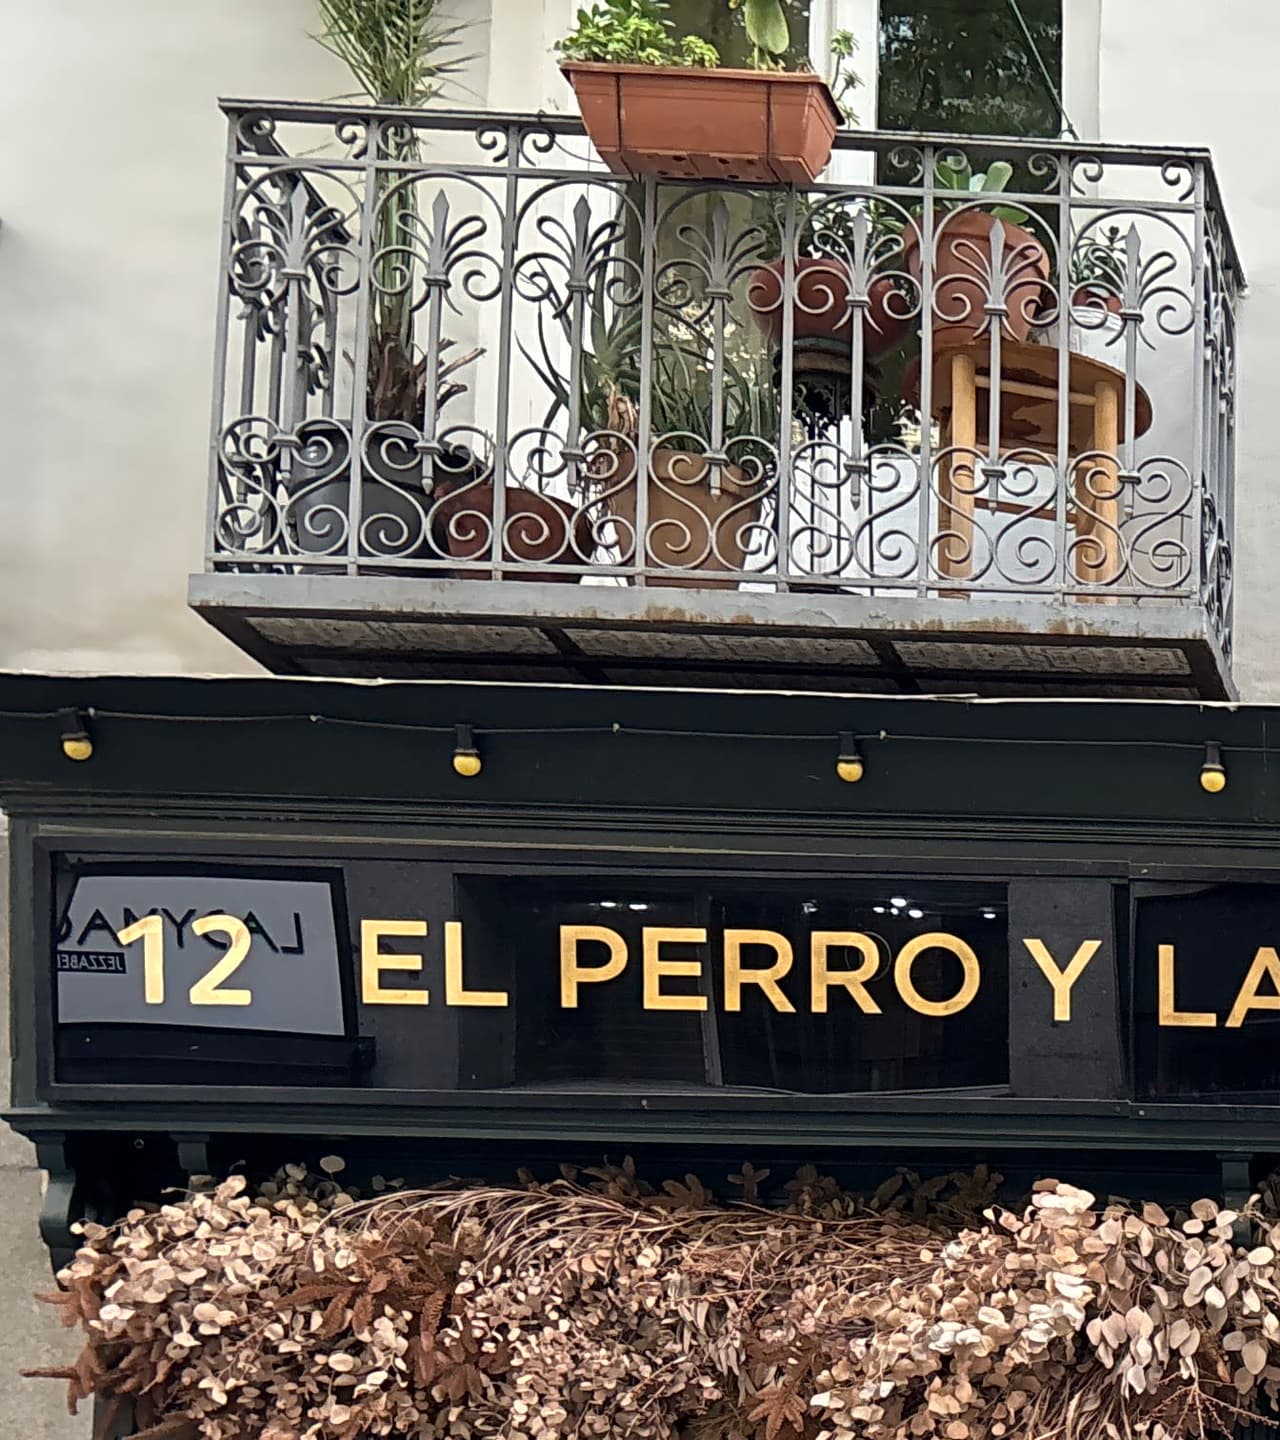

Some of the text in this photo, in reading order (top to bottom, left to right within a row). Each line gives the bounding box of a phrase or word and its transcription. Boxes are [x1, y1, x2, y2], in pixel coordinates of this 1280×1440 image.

[117, 915, 252, 1005] 12
[361, 920, 508, 1006] EL
[560, 925, 980, 1016] PERRO
[1024, 939, 1101, 1021] Y
